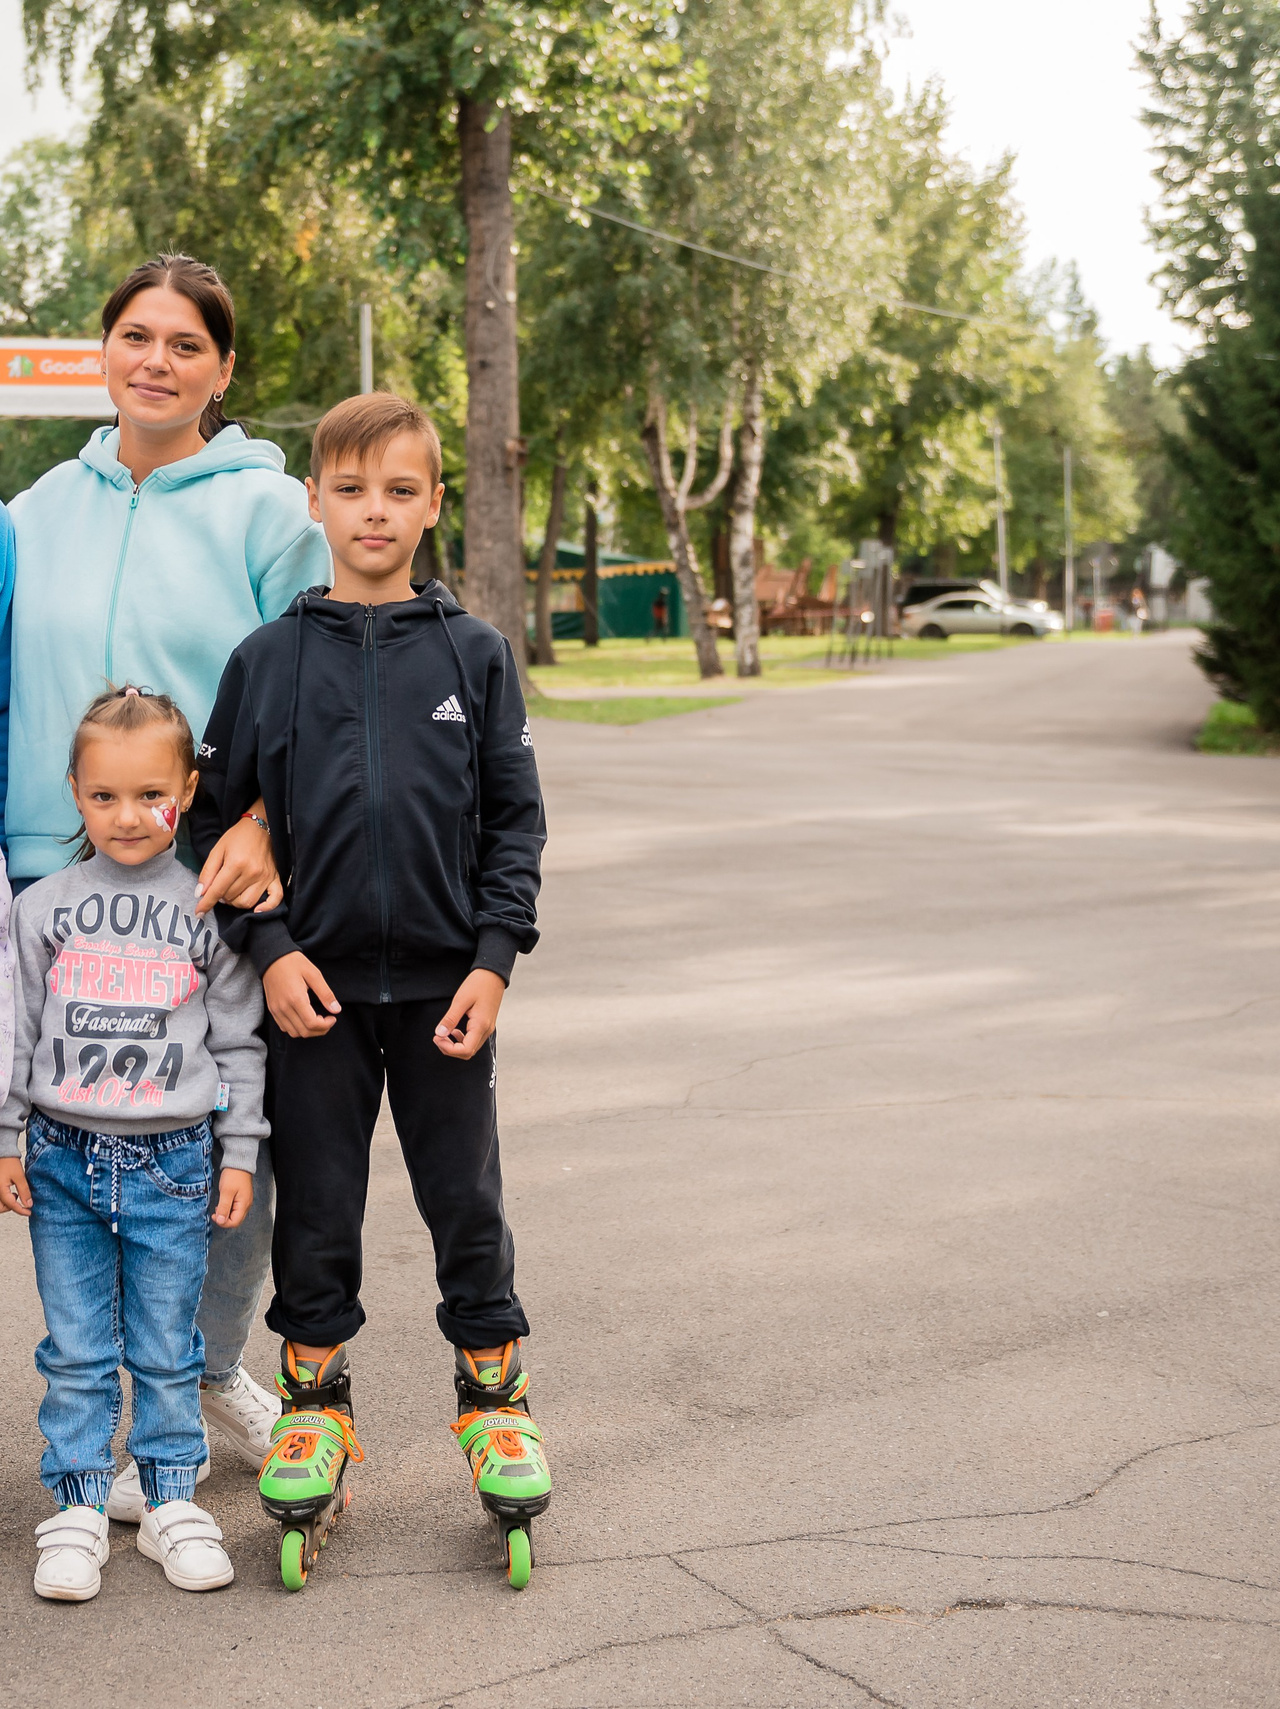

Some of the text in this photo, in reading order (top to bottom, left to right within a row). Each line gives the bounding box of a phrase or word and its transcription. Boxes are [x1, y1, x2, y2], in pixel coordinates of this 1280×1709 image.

[432, 711, 466, 723] adidas
[74, 936, 121, 955] Brooklyn
[50, 1037, 183, 1091] 1994
[57, 1077, 163, 1107] List Of City
[290, 1416, 325, 1425] JOYFULL
[483, 1418, 519, 1428] JOYFULL
